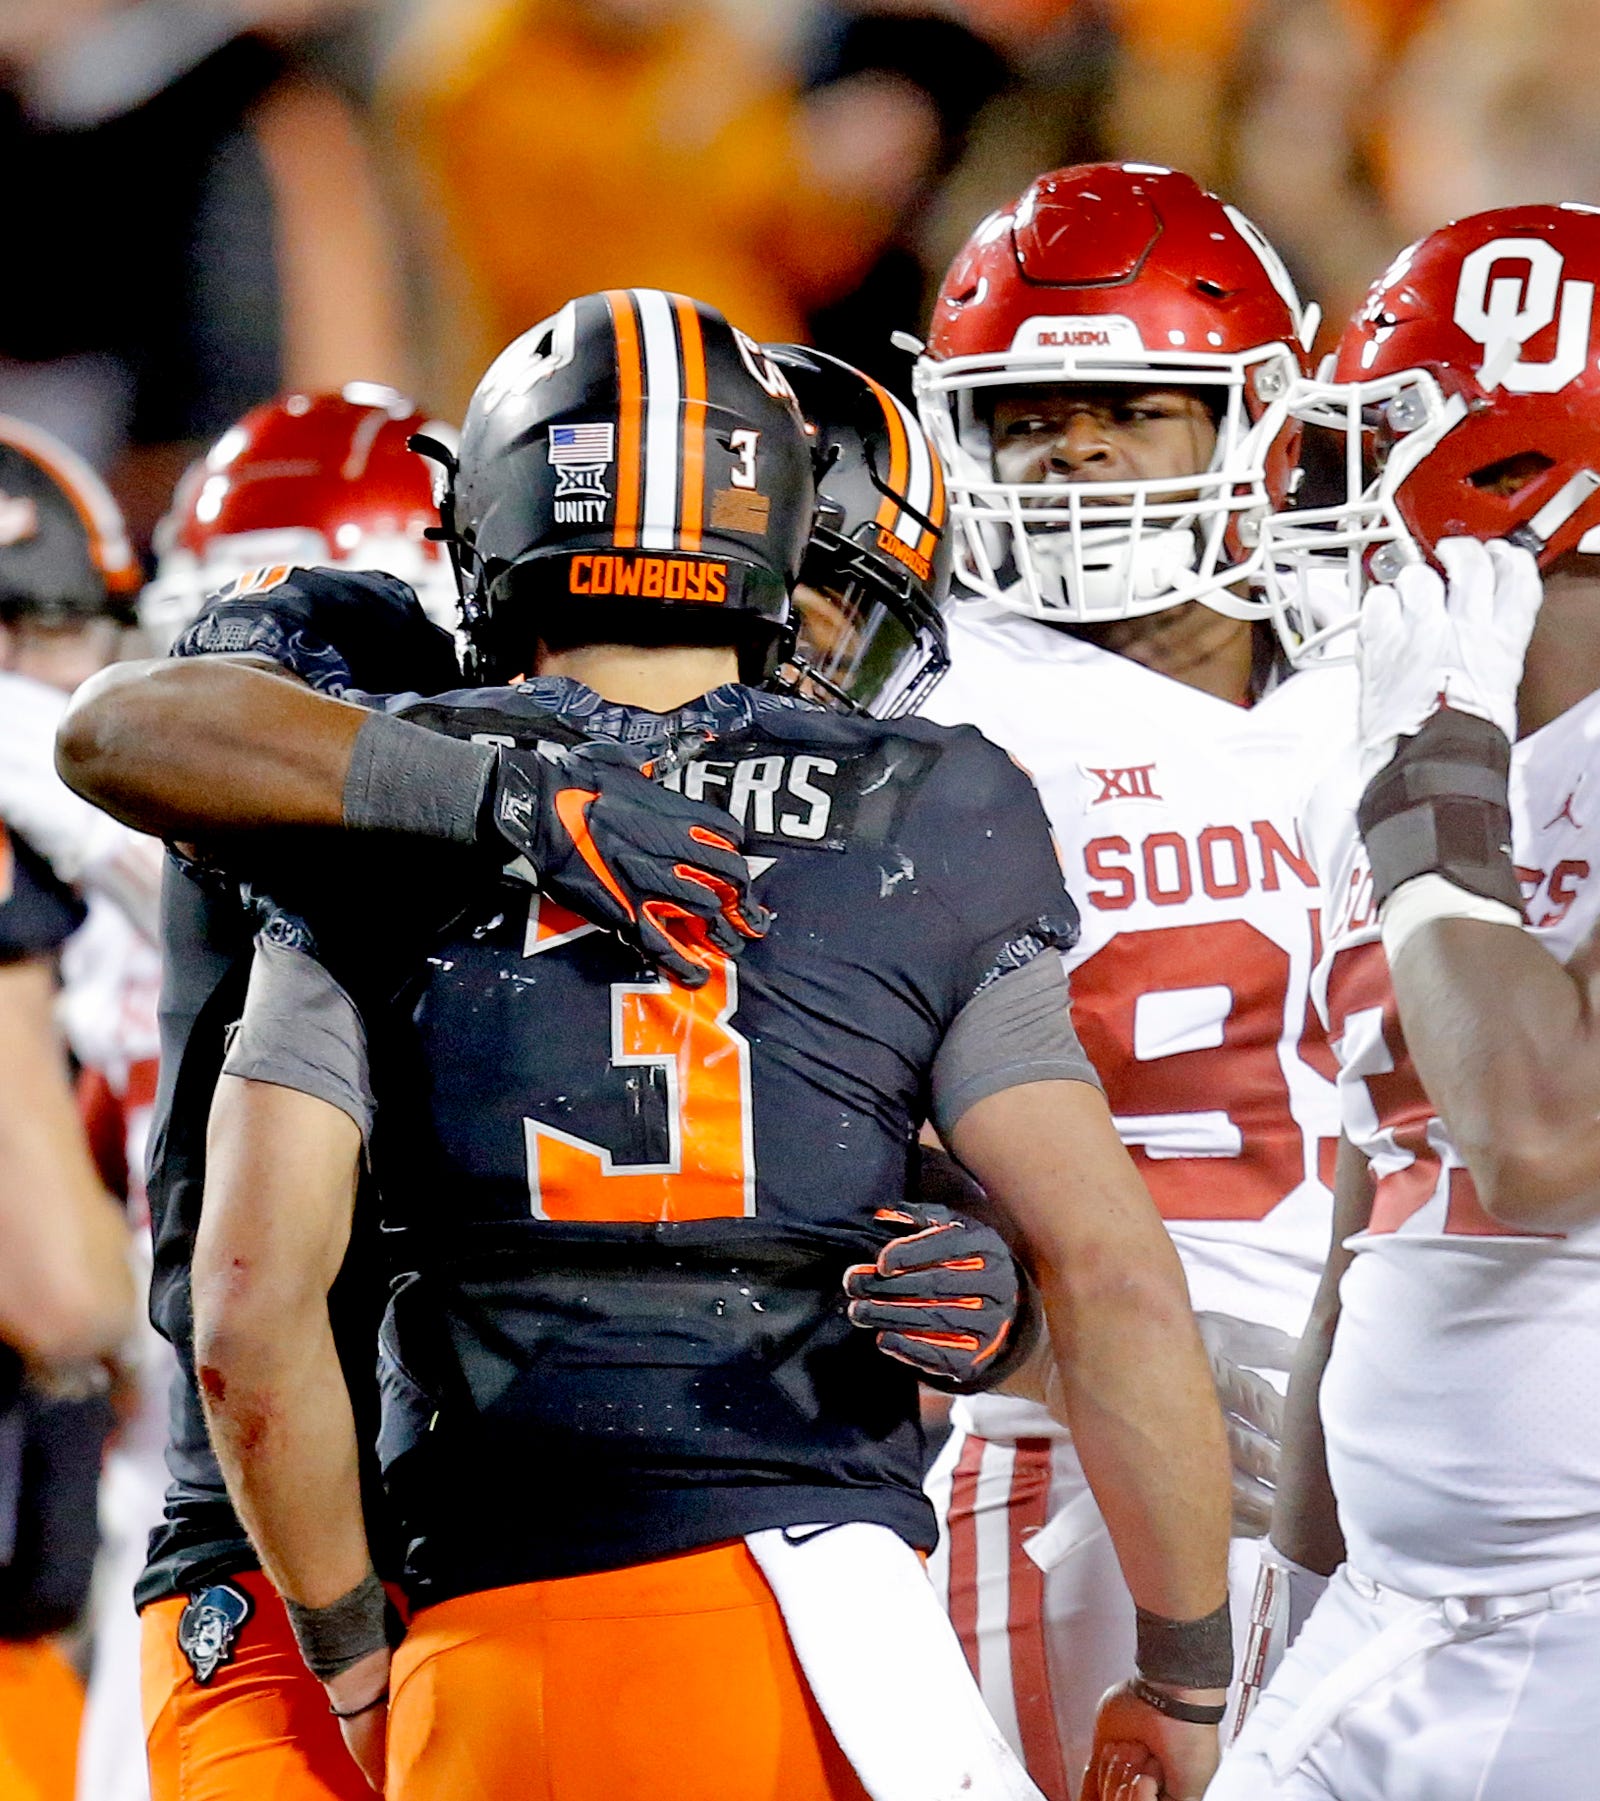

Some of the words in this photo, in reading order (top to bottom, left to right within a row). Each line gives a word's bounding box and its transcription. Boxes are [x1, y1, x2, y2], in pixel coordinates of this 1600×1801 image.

[1037, 330, 1110, 347] OKLAHOMA
[1453, 238, 1595, 394] OU
[729, 428, 761, 490] 3
[553, 499, 607, 524] UNITY
[569, 554, 728, 604] COWBOYS
[1086, 762, 1164, 806] XII
[1083, 817, 1321, 912] SOON
